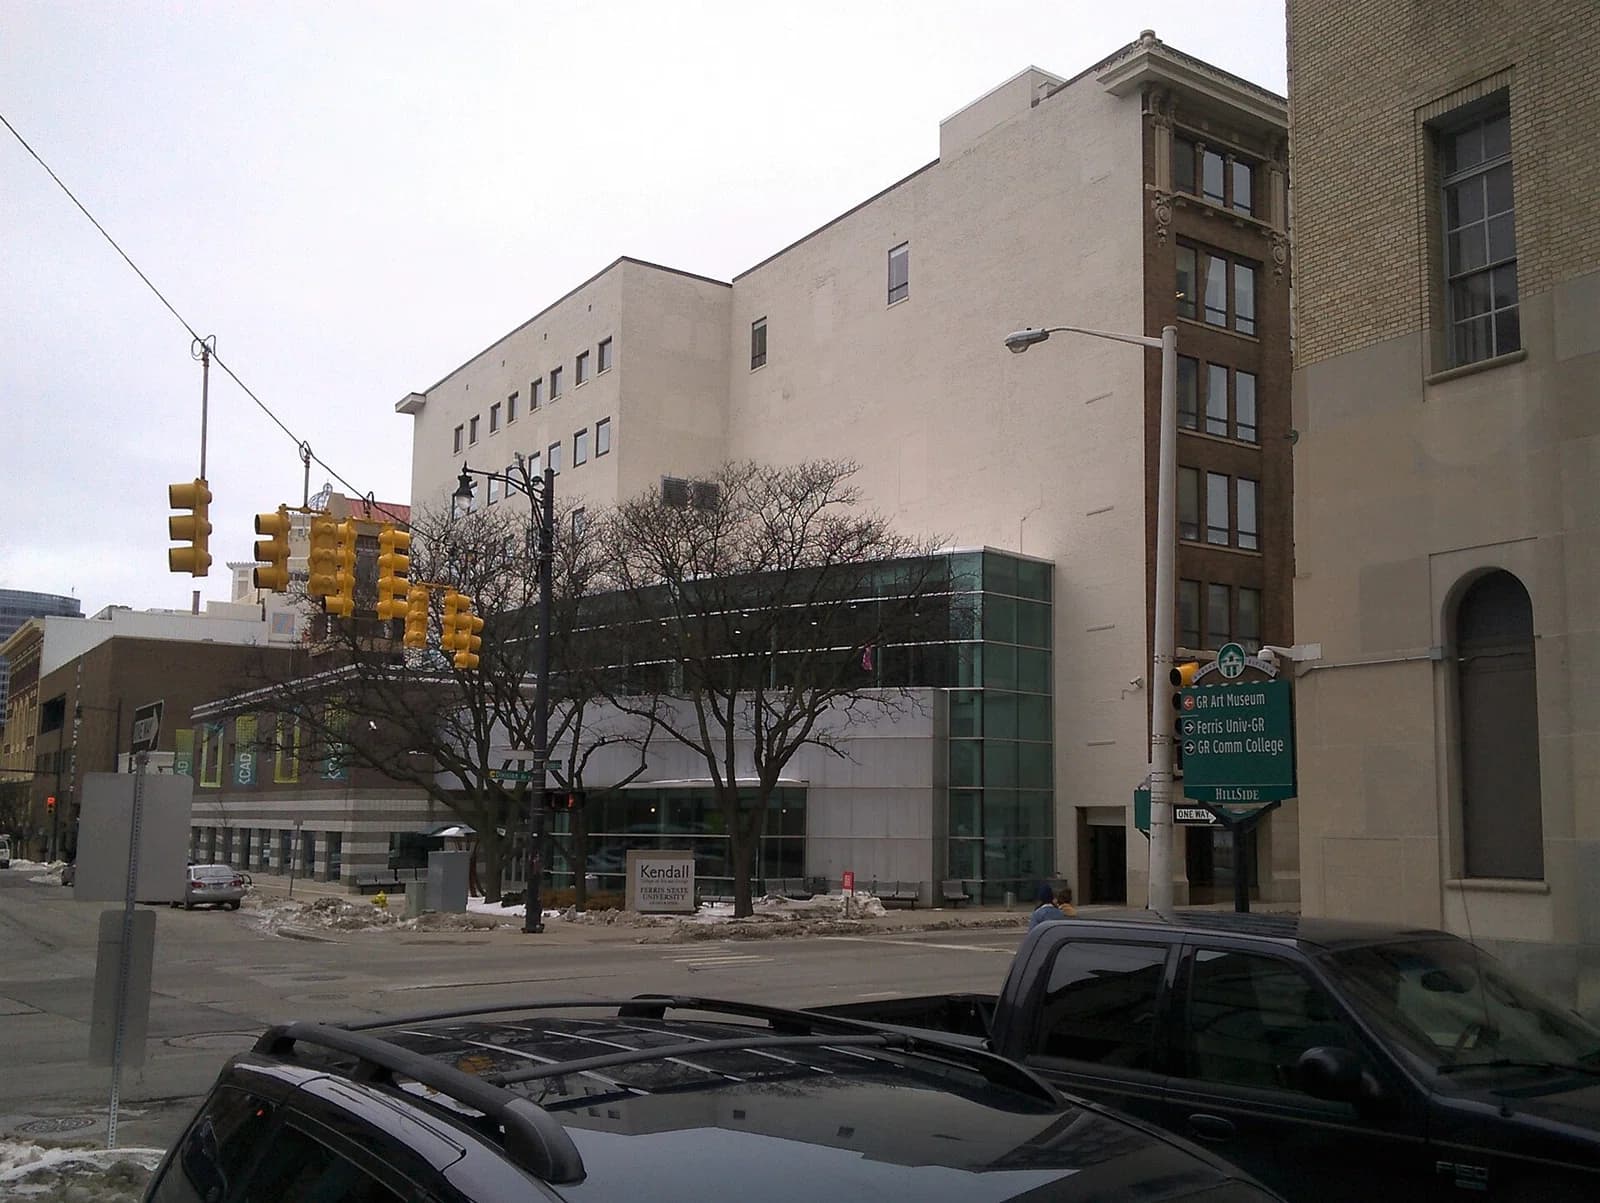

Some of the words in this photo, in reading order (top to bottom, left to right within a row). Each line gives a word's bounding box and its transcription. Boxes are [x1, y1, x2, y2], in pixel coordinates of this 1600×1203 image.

[1196, 695, 1208, 709] GR
[1210, 694, 1224, 708] Art
[1227, 693, 1265, 707] Museum
[1197, 718, 1223, 734] Ferris
[1226, 717, 1265, 733] Univ-GR
[1197, 740, 1210, 754] GR
[1213, 739, 1243, 754] Comm
[1245, 737, 1284, 755] College
[1177, 809, 1194, 818] ONE
[1195, 809, 1209, 819] WAY
[640, 864, 689, 878] Kendall
